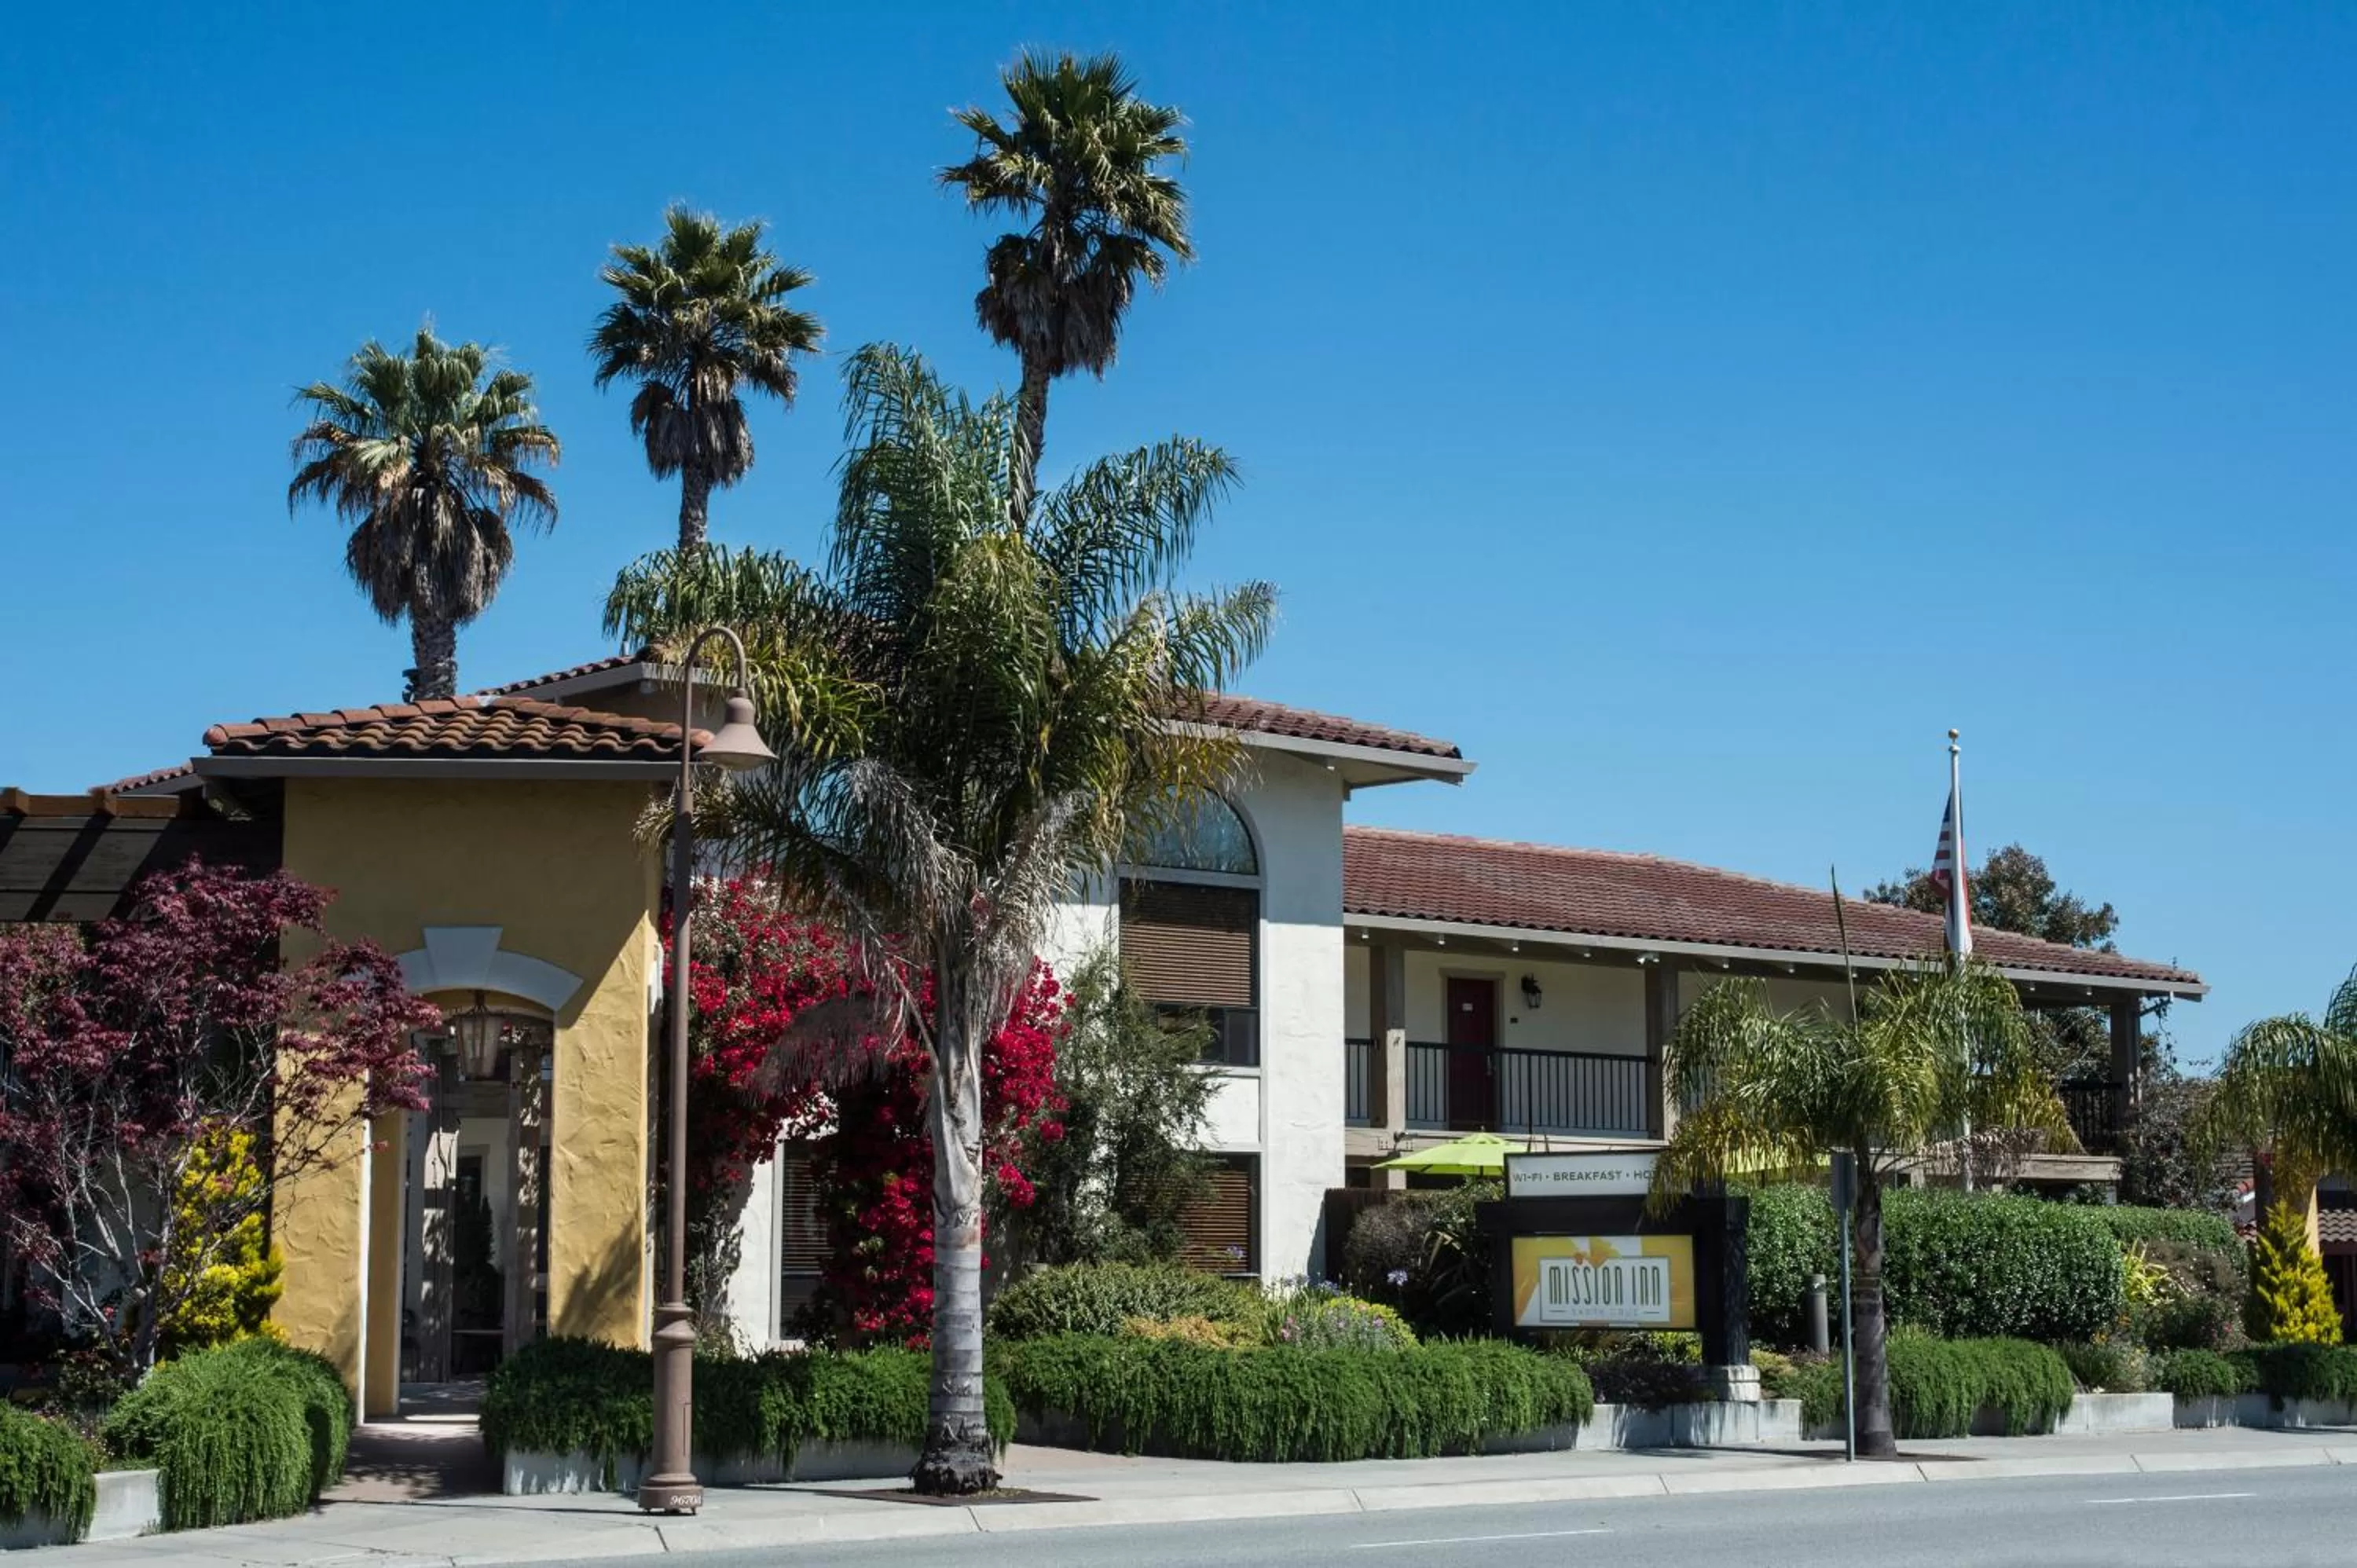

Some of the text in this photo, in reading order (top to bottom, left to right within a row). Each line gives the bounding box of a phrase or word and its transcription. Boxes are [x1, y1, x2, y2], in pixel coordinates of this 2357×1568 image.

[1513, 1172, 1542, 1181] WI-FI
[1553, 1170, 1622, 1181] BREAKFAST
[1549, 1266, 1660, 1305] MISSION INN
